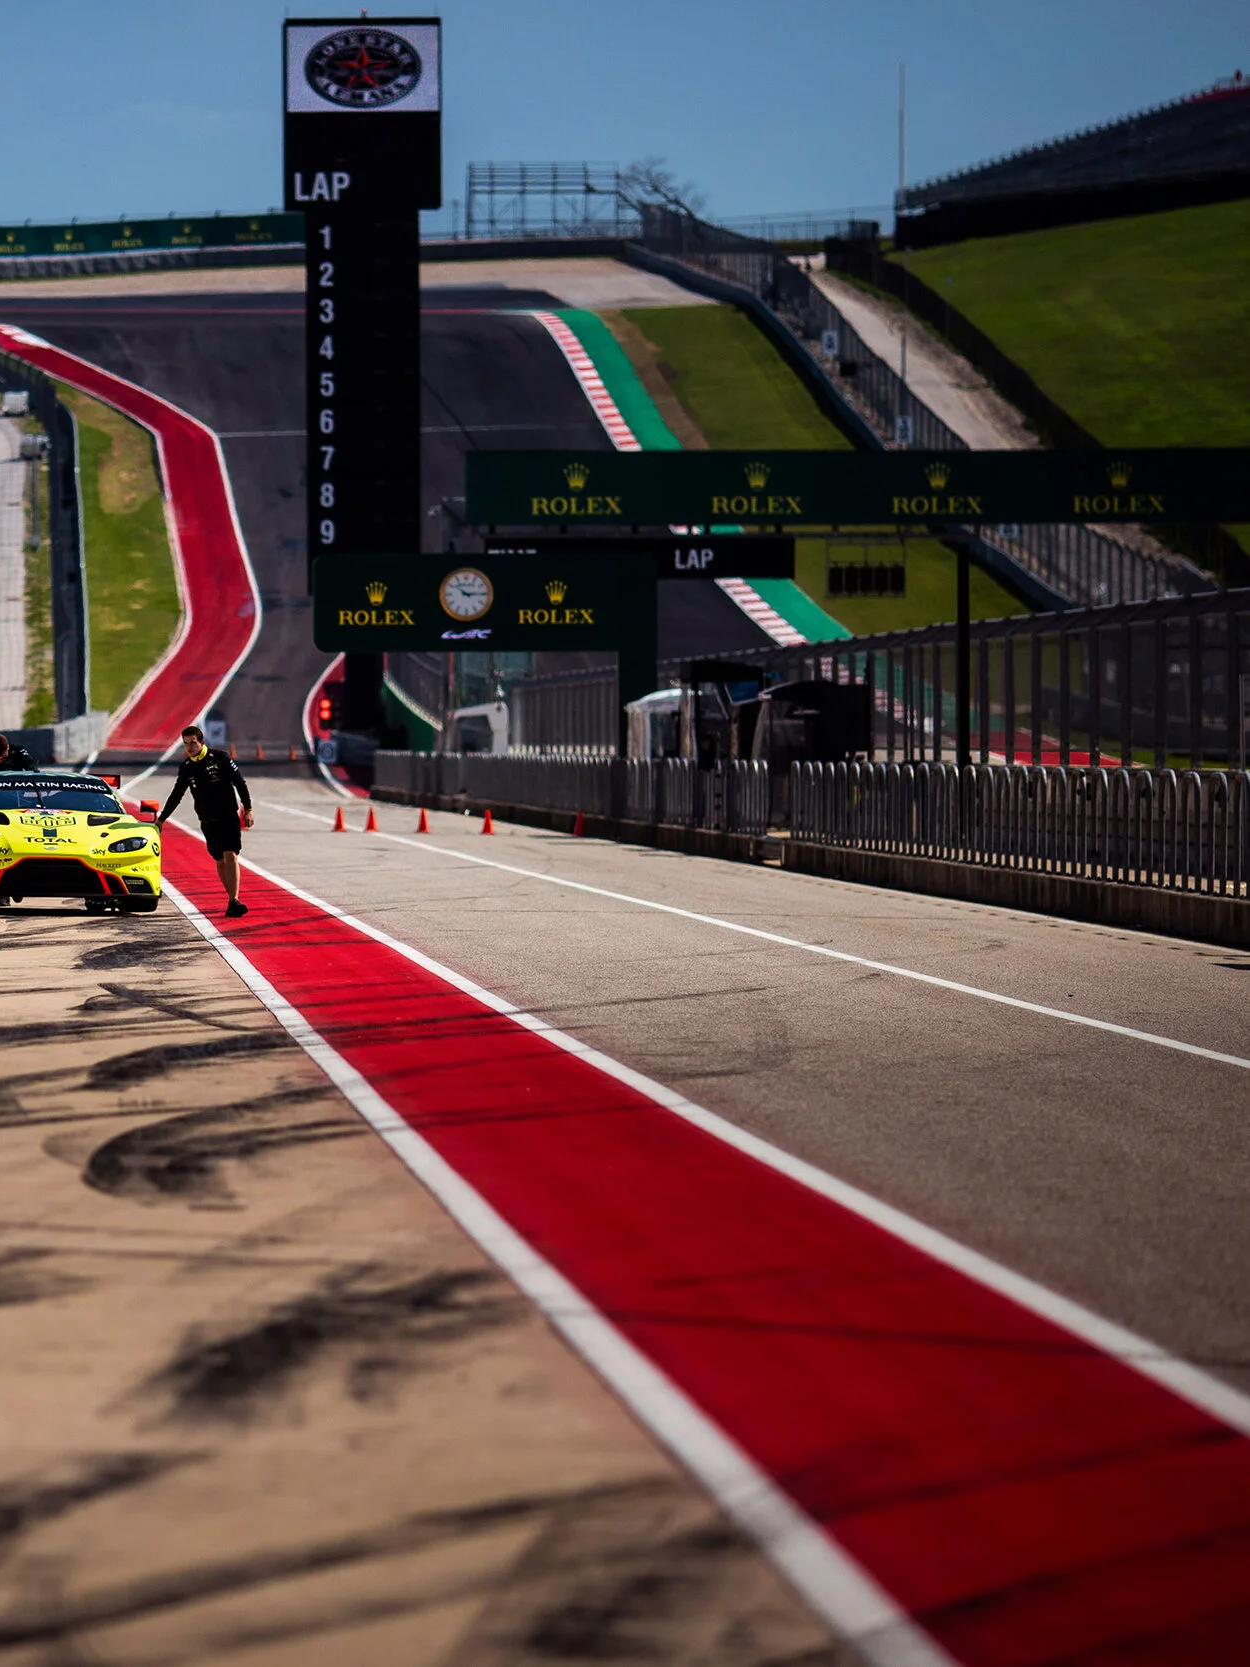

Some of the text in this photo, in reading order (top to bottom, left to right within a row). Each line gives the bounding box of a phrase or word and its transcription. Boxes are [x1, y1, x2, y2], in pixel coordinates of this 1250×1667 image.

[294, 172, 350, 201] LAP
[318, 225, 332, 249] 1
[319, 262, 335, 287] 2
[319, 299, 335, 323] 3
[319, 335, 335, 360] 4
[319, 372, 335, 397] 5
[319, 409, 335, 434] 6
[319, 446, 335, 470] 7
[319, 483, 335, 508] 8
[530, 496, 623, 516] ROLEX
[711, 496, 803, 516] ROLEX
[892, 496, 983, 515] ROLEX
[1073, 495, 1165, 515] ROLEX
[319, 520, 335, 545] 9
[674, 549, 714, 570] LAP
[338, 609, 415, 626] ROLEX
[517, 608, 594, 625] ROLEX
[62, 782, 107, 791] RACING
[24, 836, 77, 844] TOTAL
[92, 848, 106, 856] sky
